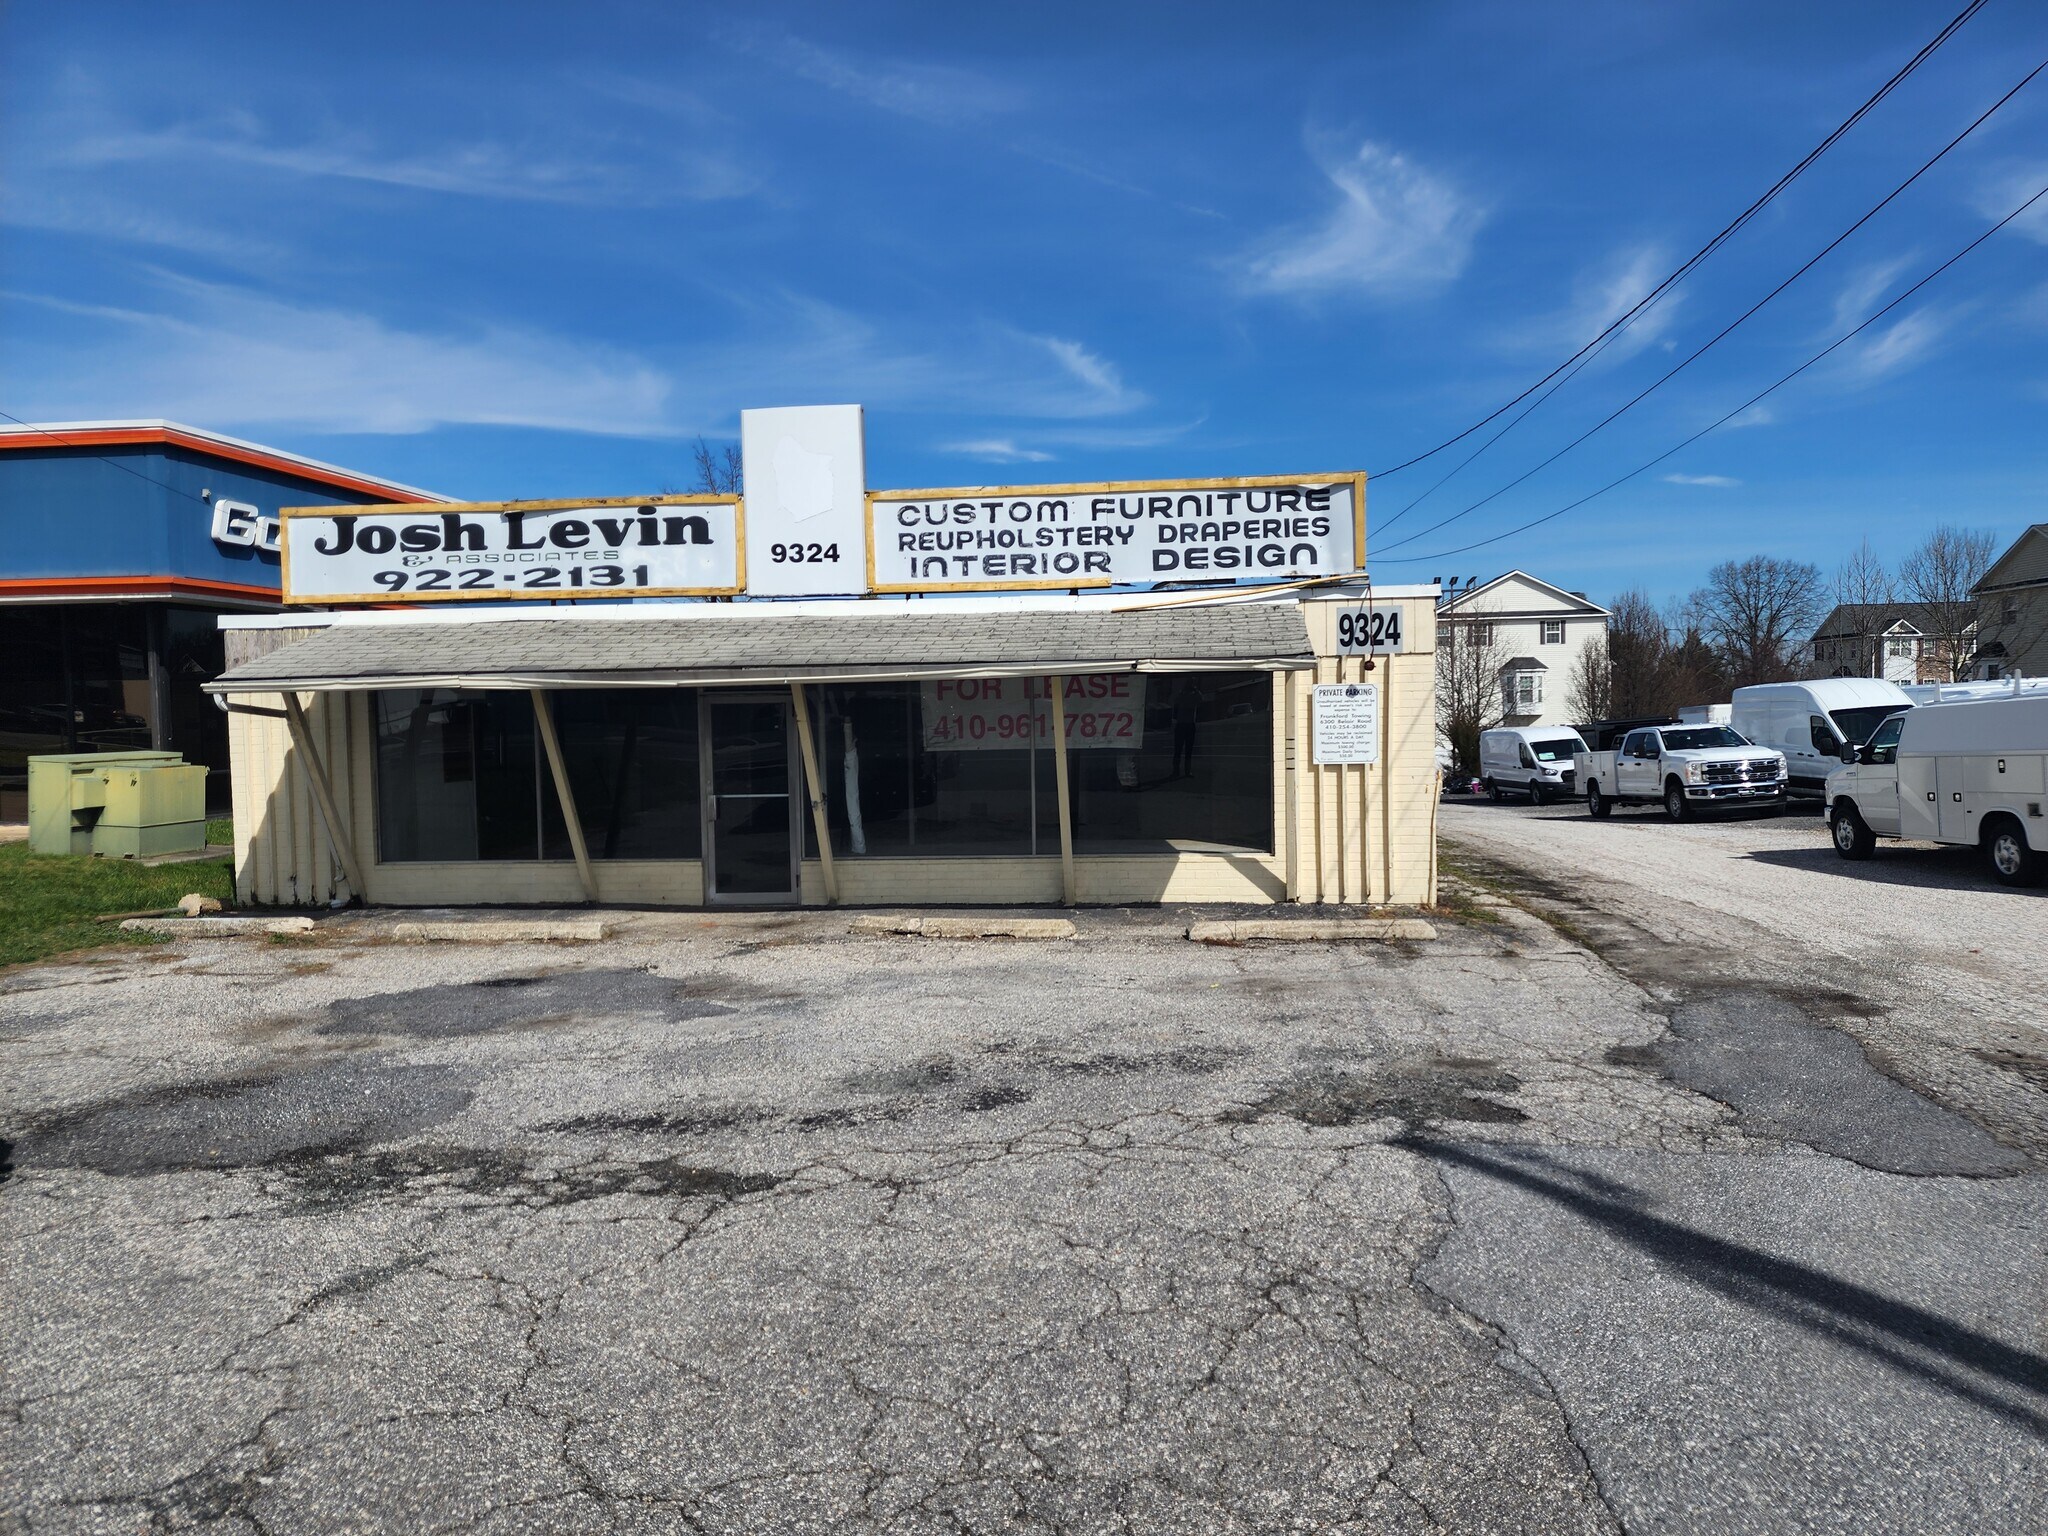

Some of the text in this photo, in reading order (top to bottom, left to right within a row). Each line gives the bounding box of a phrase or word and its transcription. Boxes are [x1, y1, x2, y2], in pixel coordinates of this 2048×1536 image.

[897, 487, 1331, 527] CUSTOM FURNITURE
[314, 506, 714, 556] Josh Levin
[898, 516, 1330, 552] REUPHOLSTERY DRAPERIES
[402, 549, 619, 567] & ASSOCIATES
[771, 543, 840, 563] 9324
[910, 543, 1318, 578] INTERIOR DESIGN
[373, 563, 649, 592] 922-2131
[1339, 612, 1401, 647] 9324
[936, 678, 1002, 701] FOR
[934, 712, 1133, 740] 410-9617872
